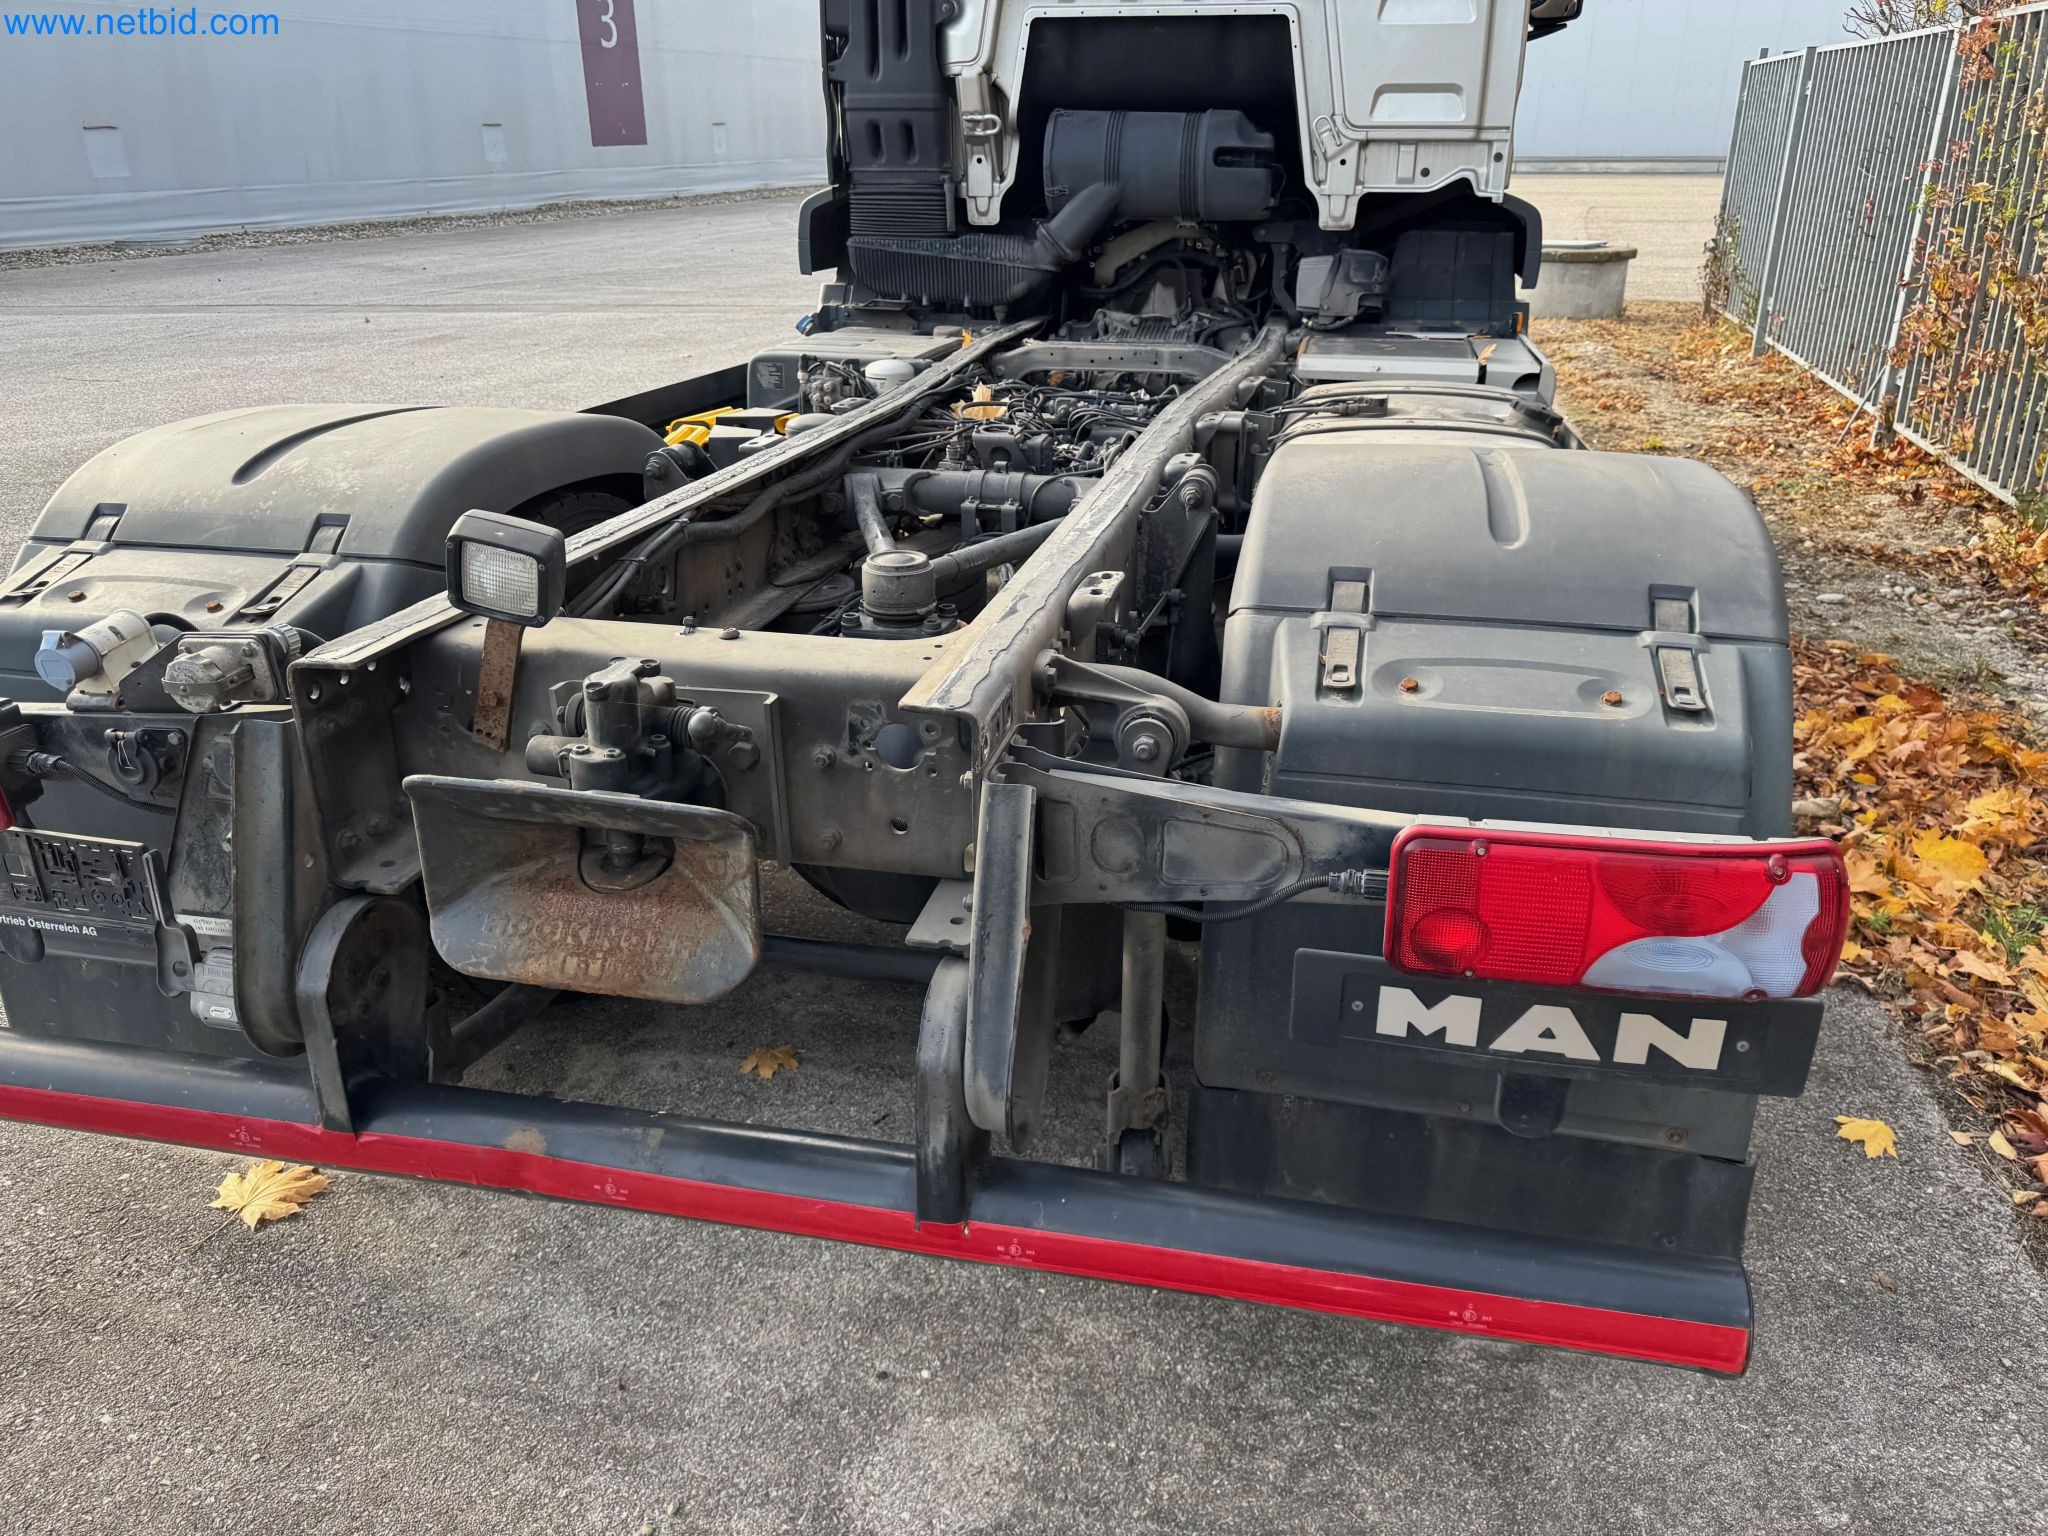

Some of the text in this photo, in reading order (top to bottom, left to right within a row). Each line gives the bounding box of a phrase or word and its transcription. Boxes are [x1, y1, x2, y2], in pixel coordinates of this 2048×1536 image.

[597, 0, 618, 48] 3
[27, 916, 80, 934] Österreich
[82, 925, 98, 937] AG
[1375, 985, 1728, 1071] MAN
